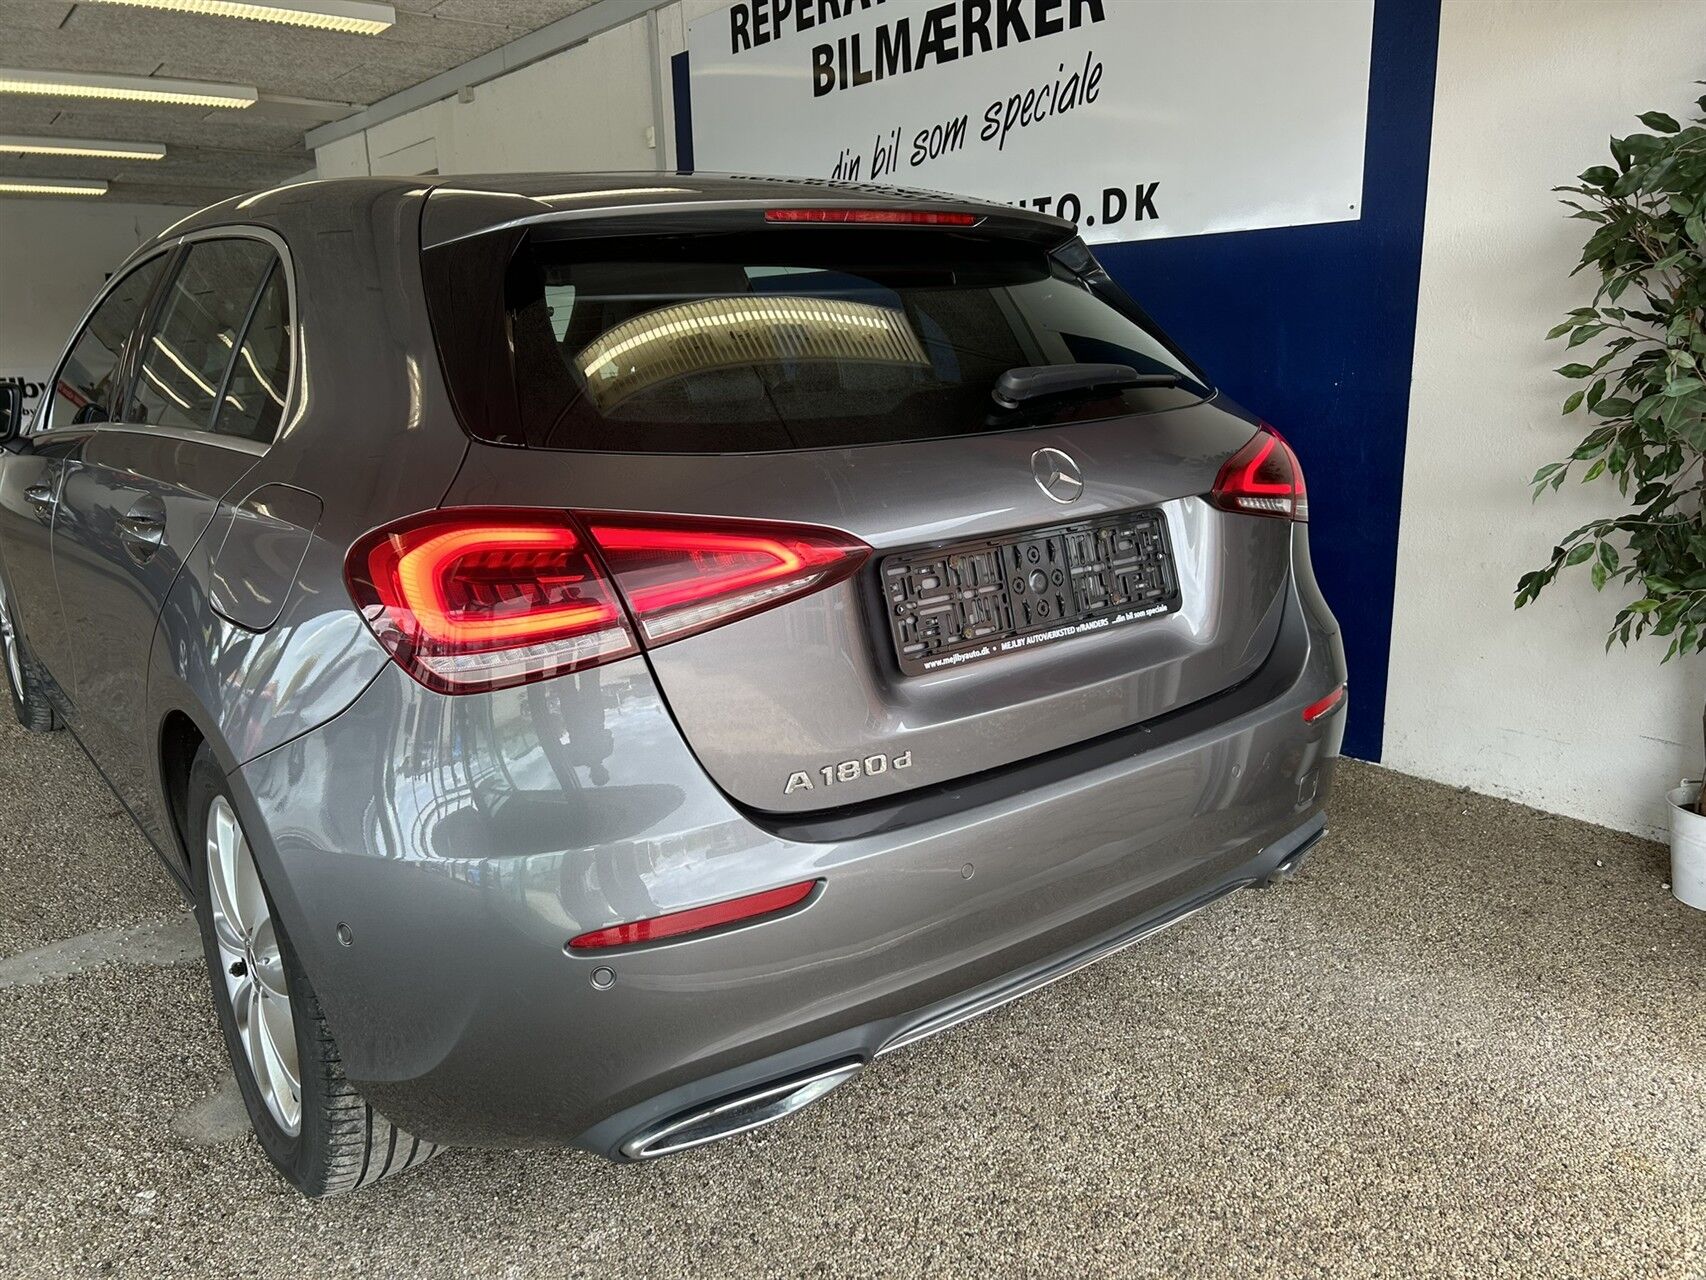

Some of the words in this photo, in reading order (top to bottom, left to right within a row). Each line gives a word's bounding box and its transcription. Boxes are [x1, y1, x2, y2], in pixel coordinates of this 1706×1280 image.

[831, 148, 861, 181] din
[871, 127, 902, 180] bil
[910, 114, 968, 167] som
[980, 50, 1103, 151] speciale
[924, 646, 990, 669] www.mejlbyauto.dk
[1001, 637, 1027, 651] MEJLBY
[1026, 626, 1075, 645] AUTOVÆRKSTED
[1125, 611, 1133, 620] bil
[1133, 610, 1146, 619] som
[1146, 604, 1168, 617] speciale
[784, 770, 814, 794] A
[820, 753, 888, 786] 180
[892, 750, 912, 770] d
